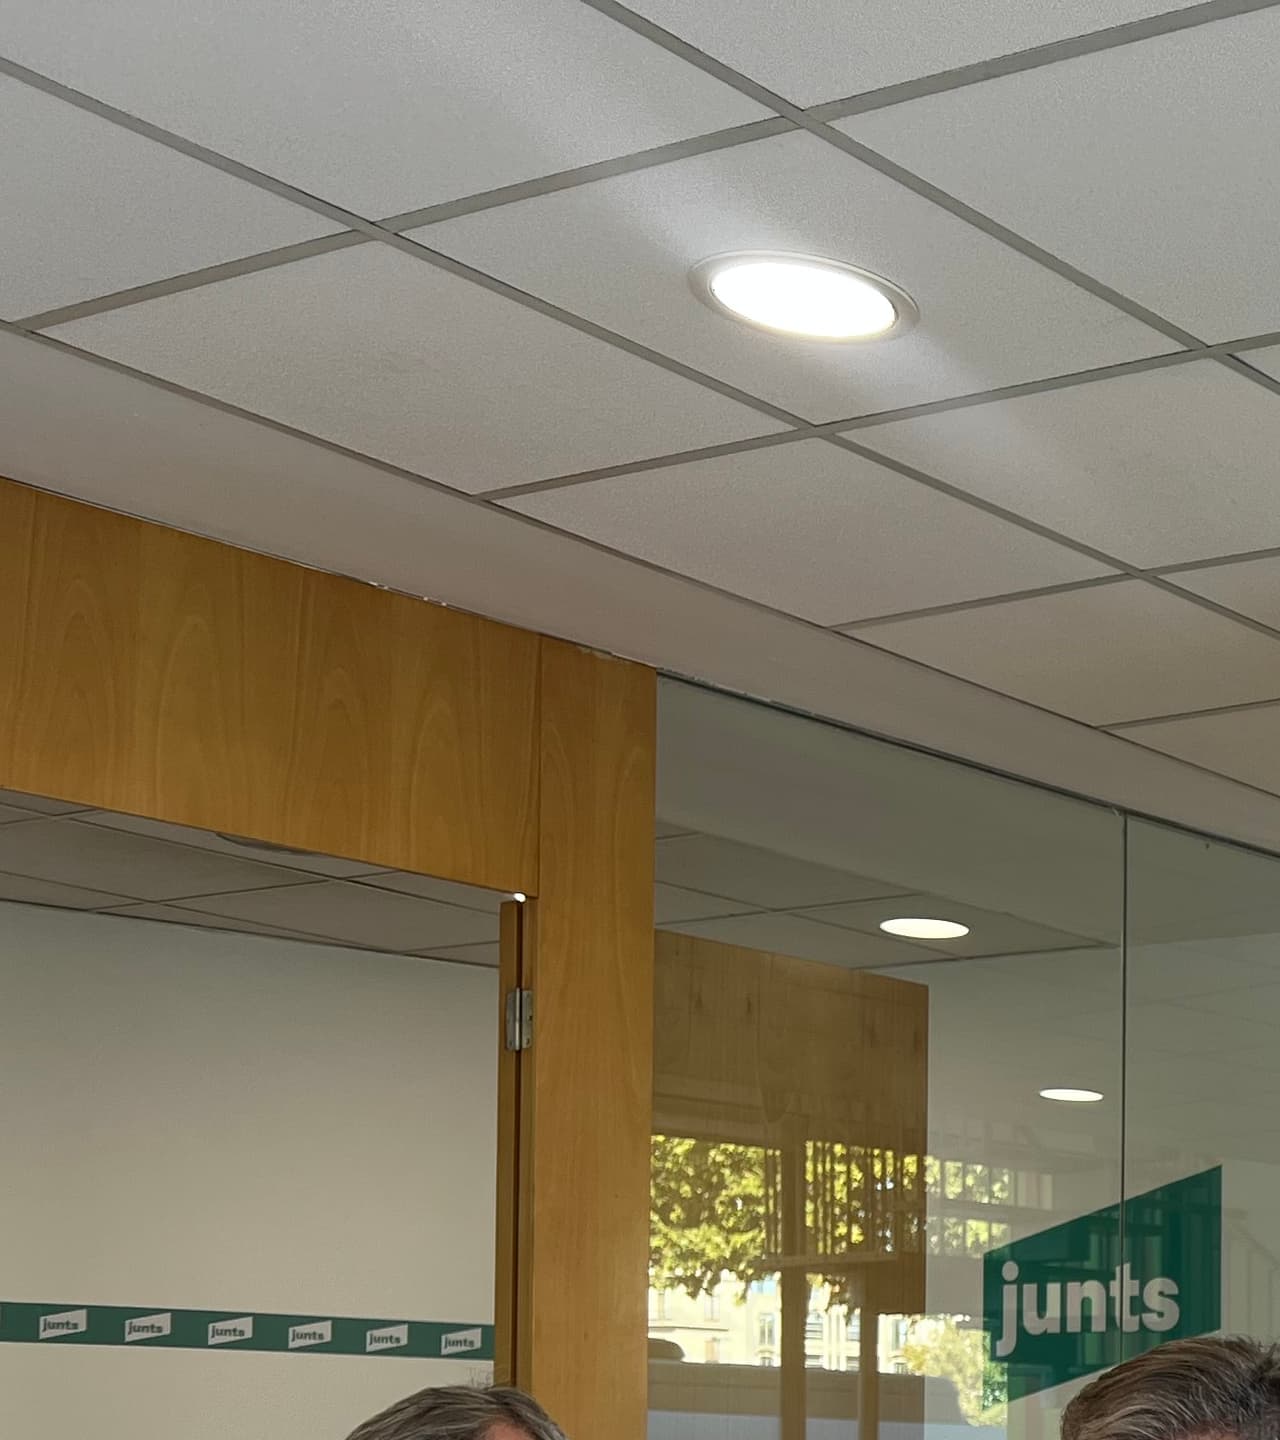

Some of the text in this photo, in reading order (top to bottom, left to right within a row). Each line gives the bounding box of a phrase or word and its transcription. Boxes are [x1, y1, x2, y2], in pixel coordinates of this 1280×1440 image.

[995, 1261, 1180, 1357] junts
[42, 1317, 79, 1335] junts
[127, 1320, 164, 1338] junts
[211, 1324, 246, 1341] junts
[290, 1328, 325, 1344] junts
[369, 1331, 401, 1347] junts
[443, 1335, 476, 1351] junts
